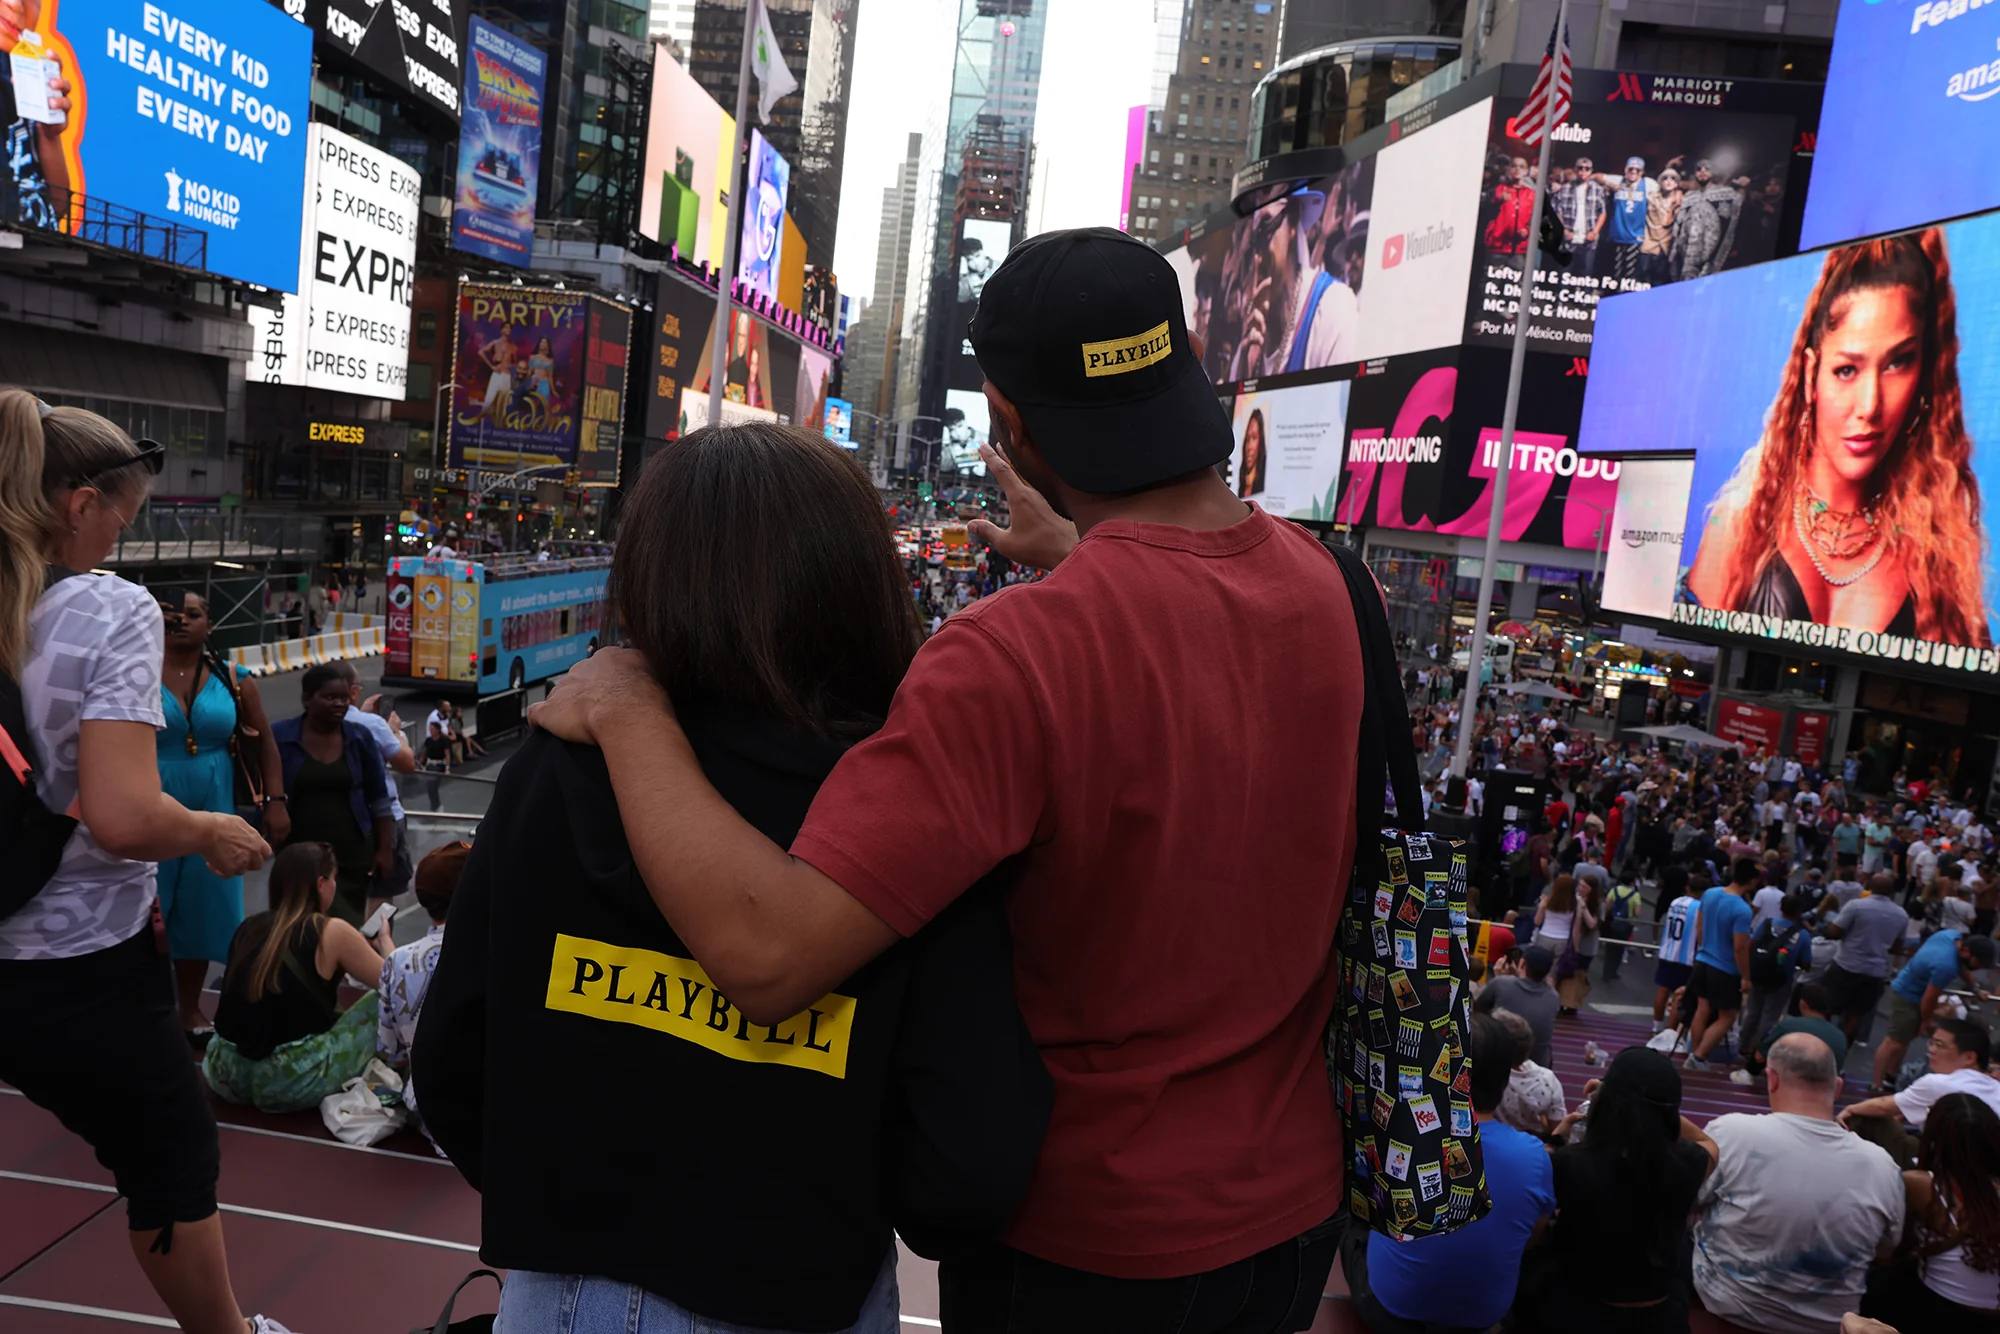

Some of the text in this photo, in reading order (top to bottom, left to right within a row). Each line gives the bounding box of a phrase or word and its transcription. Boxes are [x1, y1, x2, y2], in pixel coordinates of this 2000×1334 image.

[1910, 0, 1994, 35] Fea
[143, 2, 226, 67] EVERY
[231, 54, 270, 89] KID
[107, 28, 292, 138] HEALTHY FOOD
[404, 55, 459, 111] XPRESS
[472, 46, 541, 103] BACK
[1653, 76, 1734, 92] MARRIOTT
[1946, 58, 2000, 97] ama
[491, 88, 540, 120] FUTURE
[1651, 90, 1721, 105] MARQUIS
[137, 86, 269, 164] EVERY DAY
[1550, 122, 1592, 143] uTube
[185, 181, 241, 214] NO KID
[333, 188, 404, 236] EXPRESS
[184, 204, 240, 230] HUNGRY
[1405, 224, 1454, 260] YouTube
[1485, 281, 1501, 296] ft.
[1487, 265, 1522, 282] Lefty
[1531, 270, 1546, 283] M
[1548, 271, 1559, 284] &
[1561, 272, 1599, 288] Santa
[1601, 276, 1618, 290] Fe
[463, 286, 584, 306] BROADWAY'S BIGGEST
[1482, 298, 1506, 313] MC
[1543, 304, 1554, 317] &
[1556, 305, 1590, 322] Neto
[325, 310, 396, 347] EXPRESS
[472, 299, 574, 329] PARTY!
[1479, 320, 1501, 335] Por
[1503, 322, 1516, 336] M
[1088, 331, 1168, 368] PLAYBILL
[456, 389, 573, 436] Aladdin
[309, 422, 365, 445] EXPRESS
[1348, 435, 1442, 464] INTRODUCING
[414, 467, 457, 483] GITS
[1621, 528, 1658, 545] amazon
[389, 616, 412, 632] ICE
[419, 618, 445, 634] ICE
[1672, 602, 1776, 640] AMERICAN
[1780, 618, 1850, 650] EAGLE
[1668, 916, 1685, 940] 10
